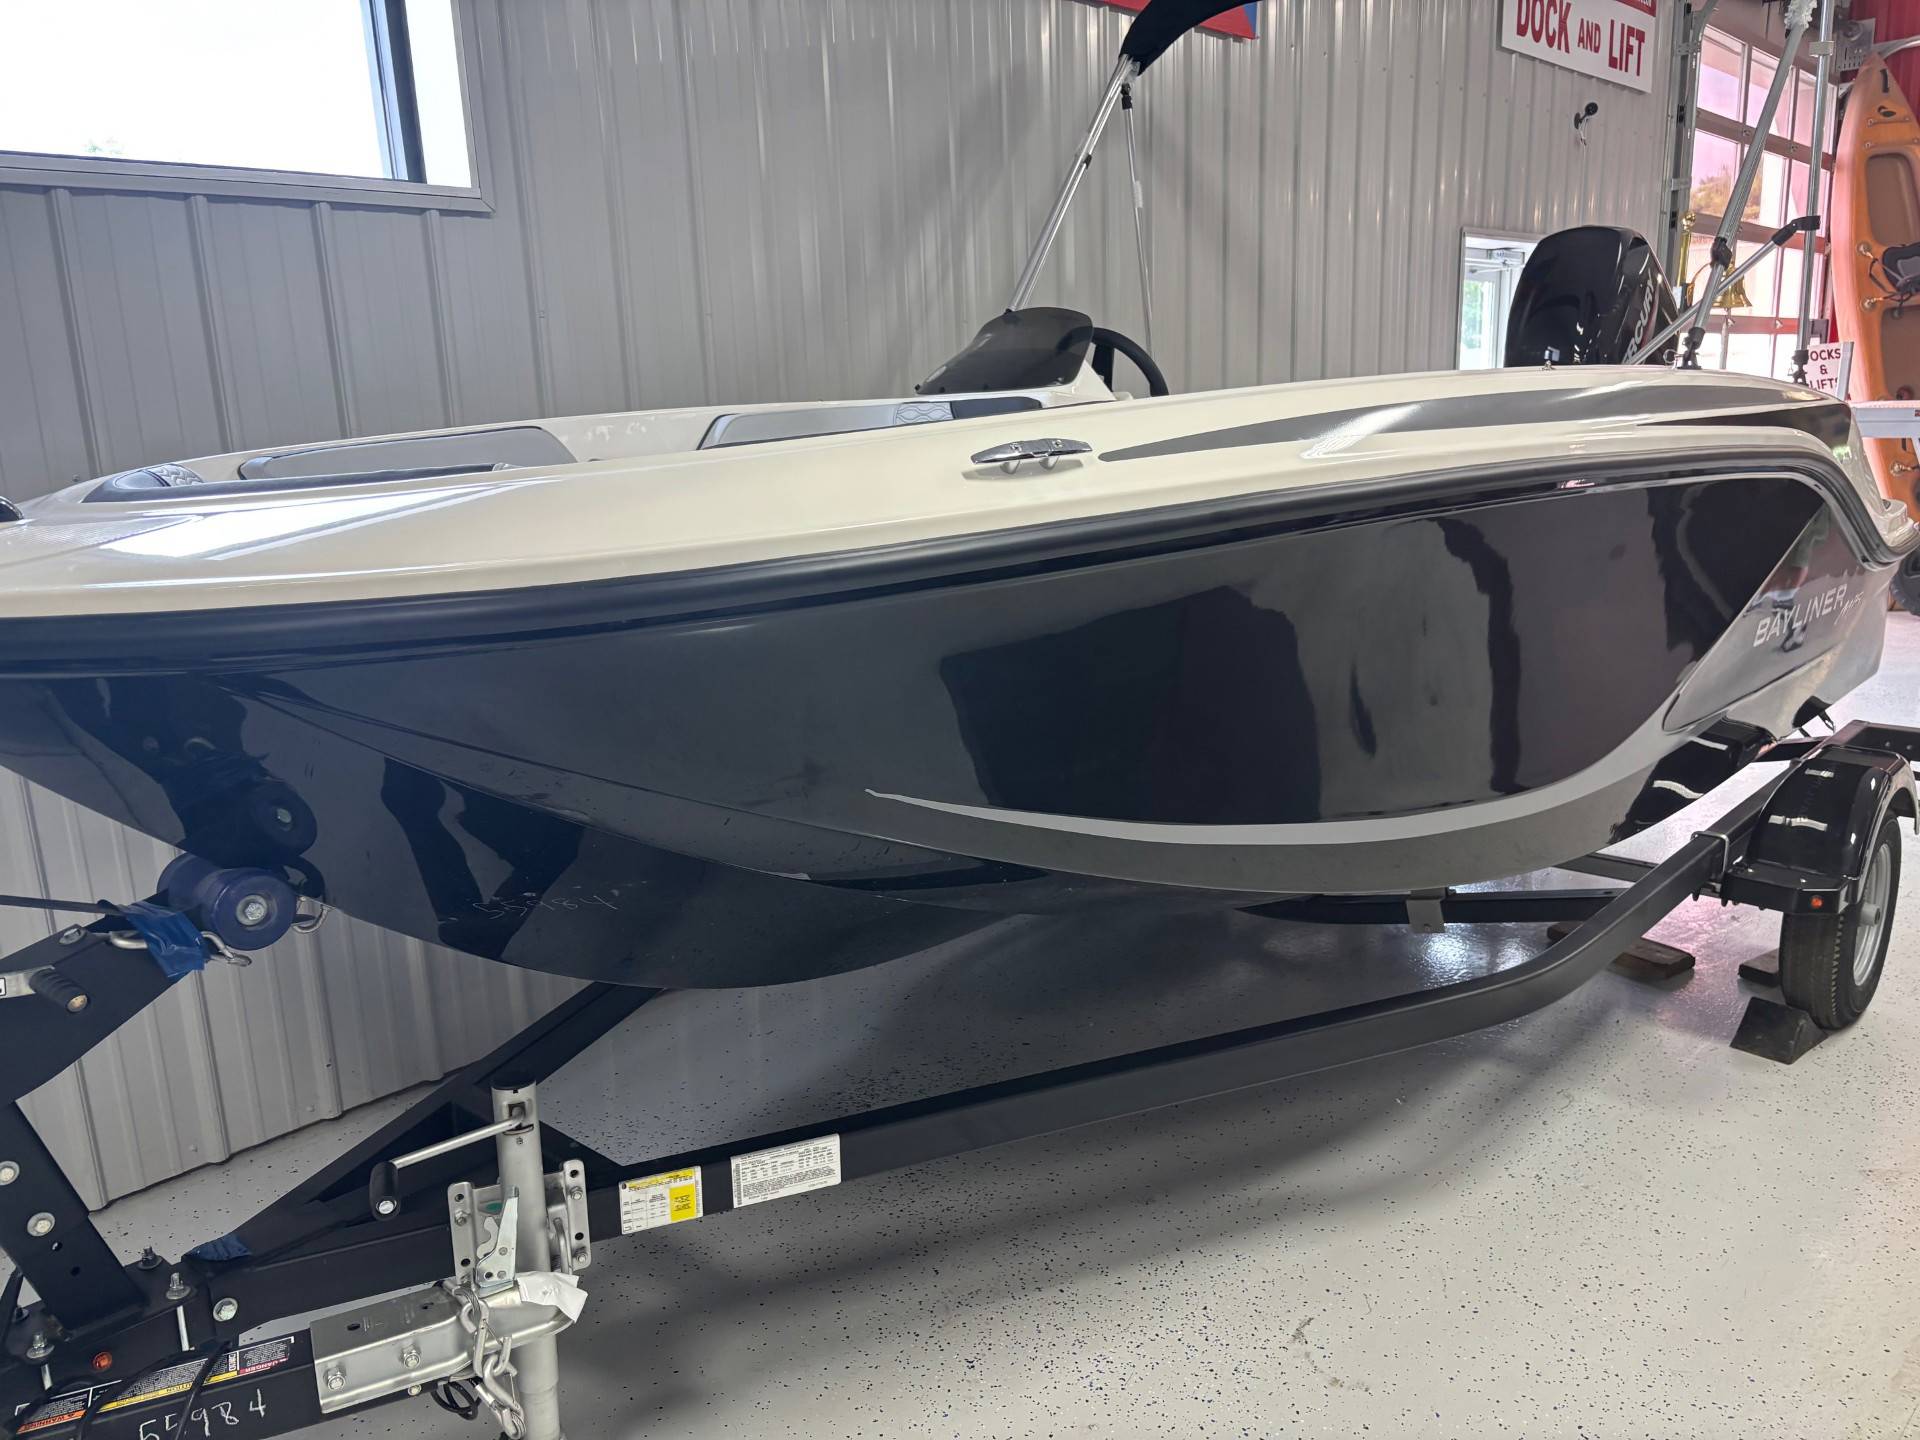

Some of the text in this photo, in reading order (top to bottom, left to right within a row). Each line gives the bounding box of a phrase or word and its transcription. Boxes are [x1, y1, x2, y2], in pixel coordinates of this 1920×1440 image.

[1516, 0, 1646, 76] DOCK AND LIFT
[1809, 348, 1841, 361] OCKS
[1819, 364, 1828, 375] &
[1753, 584, 1847, 647] BAYLINER
